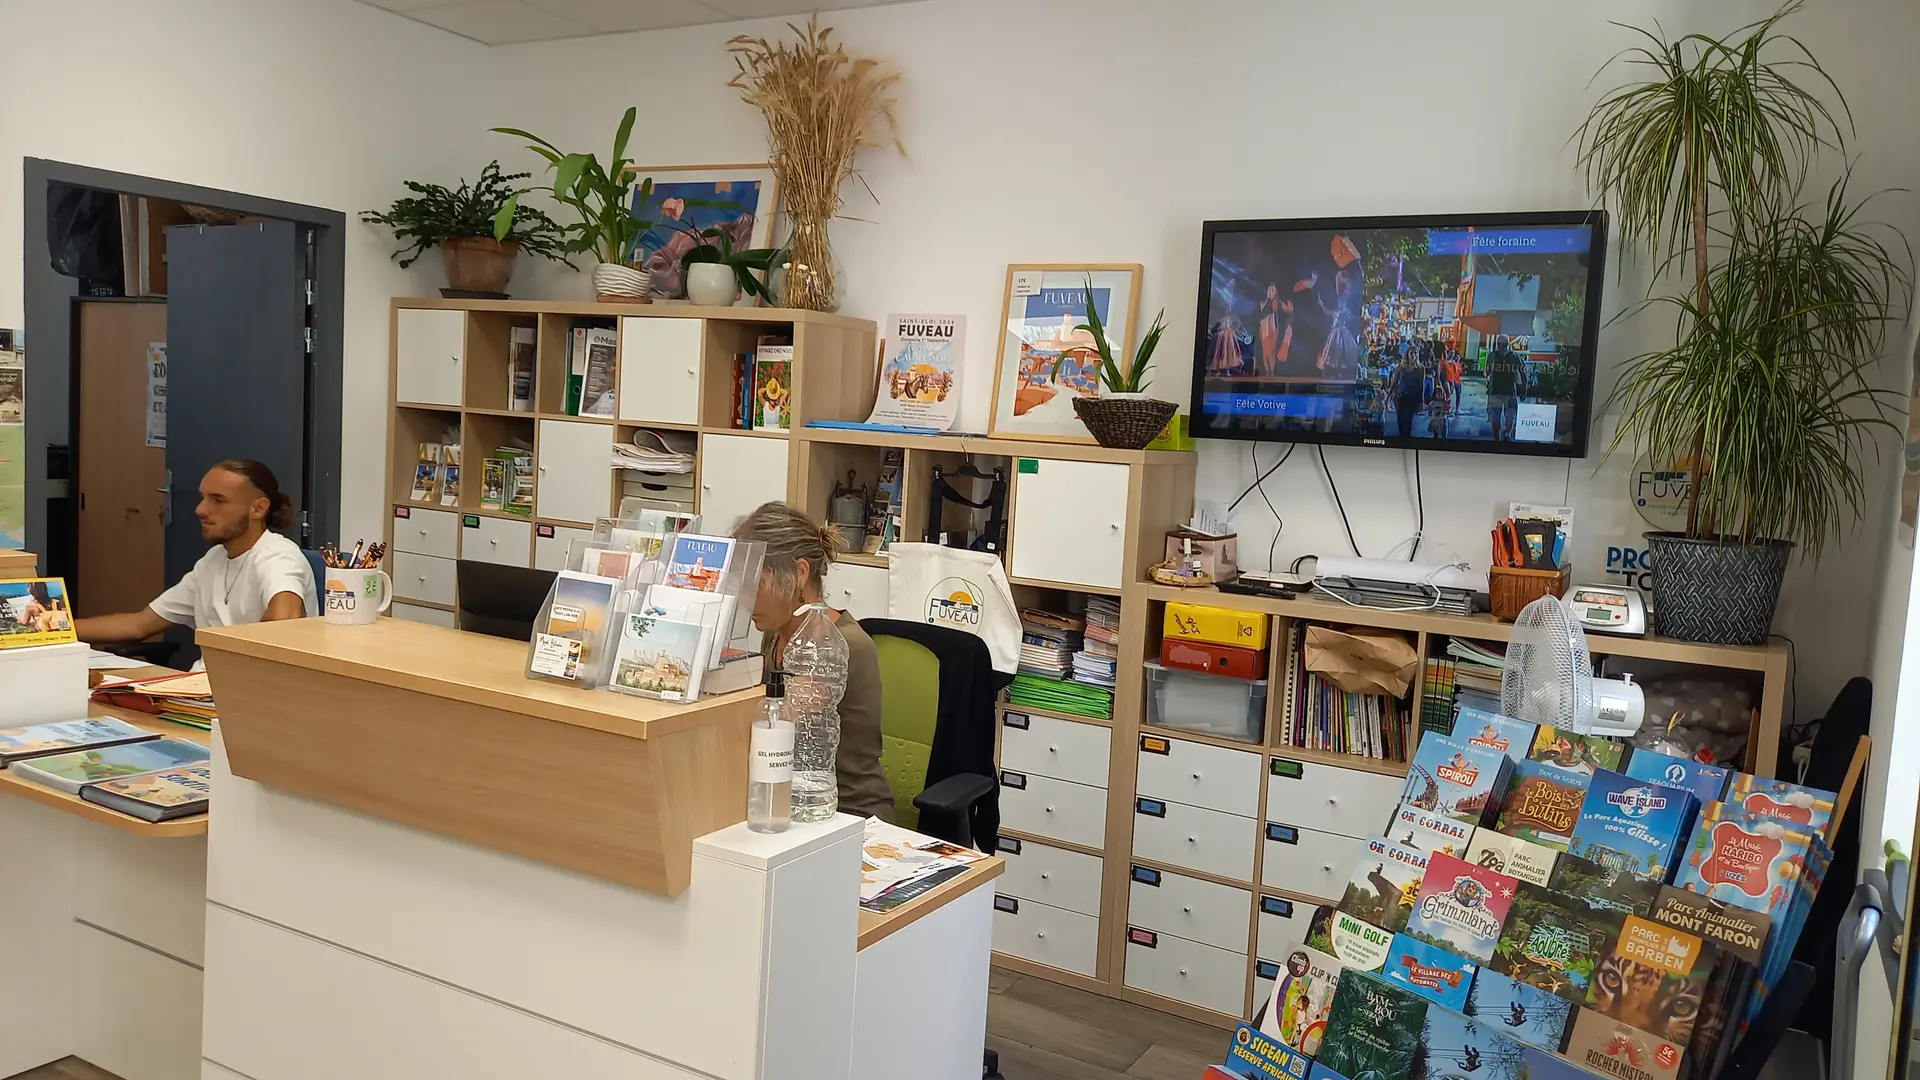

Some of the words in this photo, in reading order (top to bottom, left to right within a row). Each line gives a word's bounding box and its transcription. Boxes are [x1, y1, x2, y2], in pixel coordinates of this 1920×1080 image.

[1472, 235, 1495, 247] Fête
[1498, 235, 1537, 247] foraine
[898, 325, 954, 337] FUVEAU
[1236, 399, 1255, 409] Fête
[1257, 400, 1287, 410] Votive
[1521, 419, 1550, 428] FUVEAU
[929, 598, 979, 625] FUVEAU
[1438, 767, 1475, 785] SPIROU
[1538, 768, 1552, 778] Parc
[1533, 781, 1562, 803] Bois
[1608, 792, 1634, 806] WAVE
[1518, 796, 1572, 828] Lutins
[1401, 810, 1417, 823] OK
[1419, 816, 1466, 839] CORRAL
[1594, 813, 1611, 821] Parc
[1612, 815, 1650, 831] Aquatique
[1604, 824, 1625, 833] 100%
[1626, 825, 1661, 848] Glisse
[1369, 841, 1386, 855] OK
[1388, 848, 1429, 870] CORRA
[1513, 853, 1532, 864] PARC
[1721, 845, 1763, 865] HARIBO
[1507, 868, 1544, 884] BOTANIQUE
[1510, 861, 1546, 877] ANIMALIER
[1422, 895, 1498, 938] Grimmland
[1667, 897, 1694, 914] Parc
[1694, 907, 1757, 933] Animalier
[1338, 917, 1361, 935] MINI
[1363, 928, 1390, 947] GOLF
[1630, 926, 1661, 941] PARC
[1655, 907, 1703, 931] MONT
[1704, 923, 1761, 950] FARON
[1625, 942, 1684, 970] BARBEN
[1310, 966, 1325, 979] CLIP
[1411, 964, 1418, 972] LE
[1418, 967, 1440, 978] VILLAGE
[1440, 972, 1451, 980] DES
[1366, 990, 1394, 1008] BAM-
[1374, 1004, 1398, 1021] BOU
[1233, 1045, 1263, 1068] RÉSERVE
[1249, 1037, 1290, 1067] SIGEAN
[1662, 1046, 1675, 1058] 5€
[1585, 1049, 1620, 1074] ROCHER
